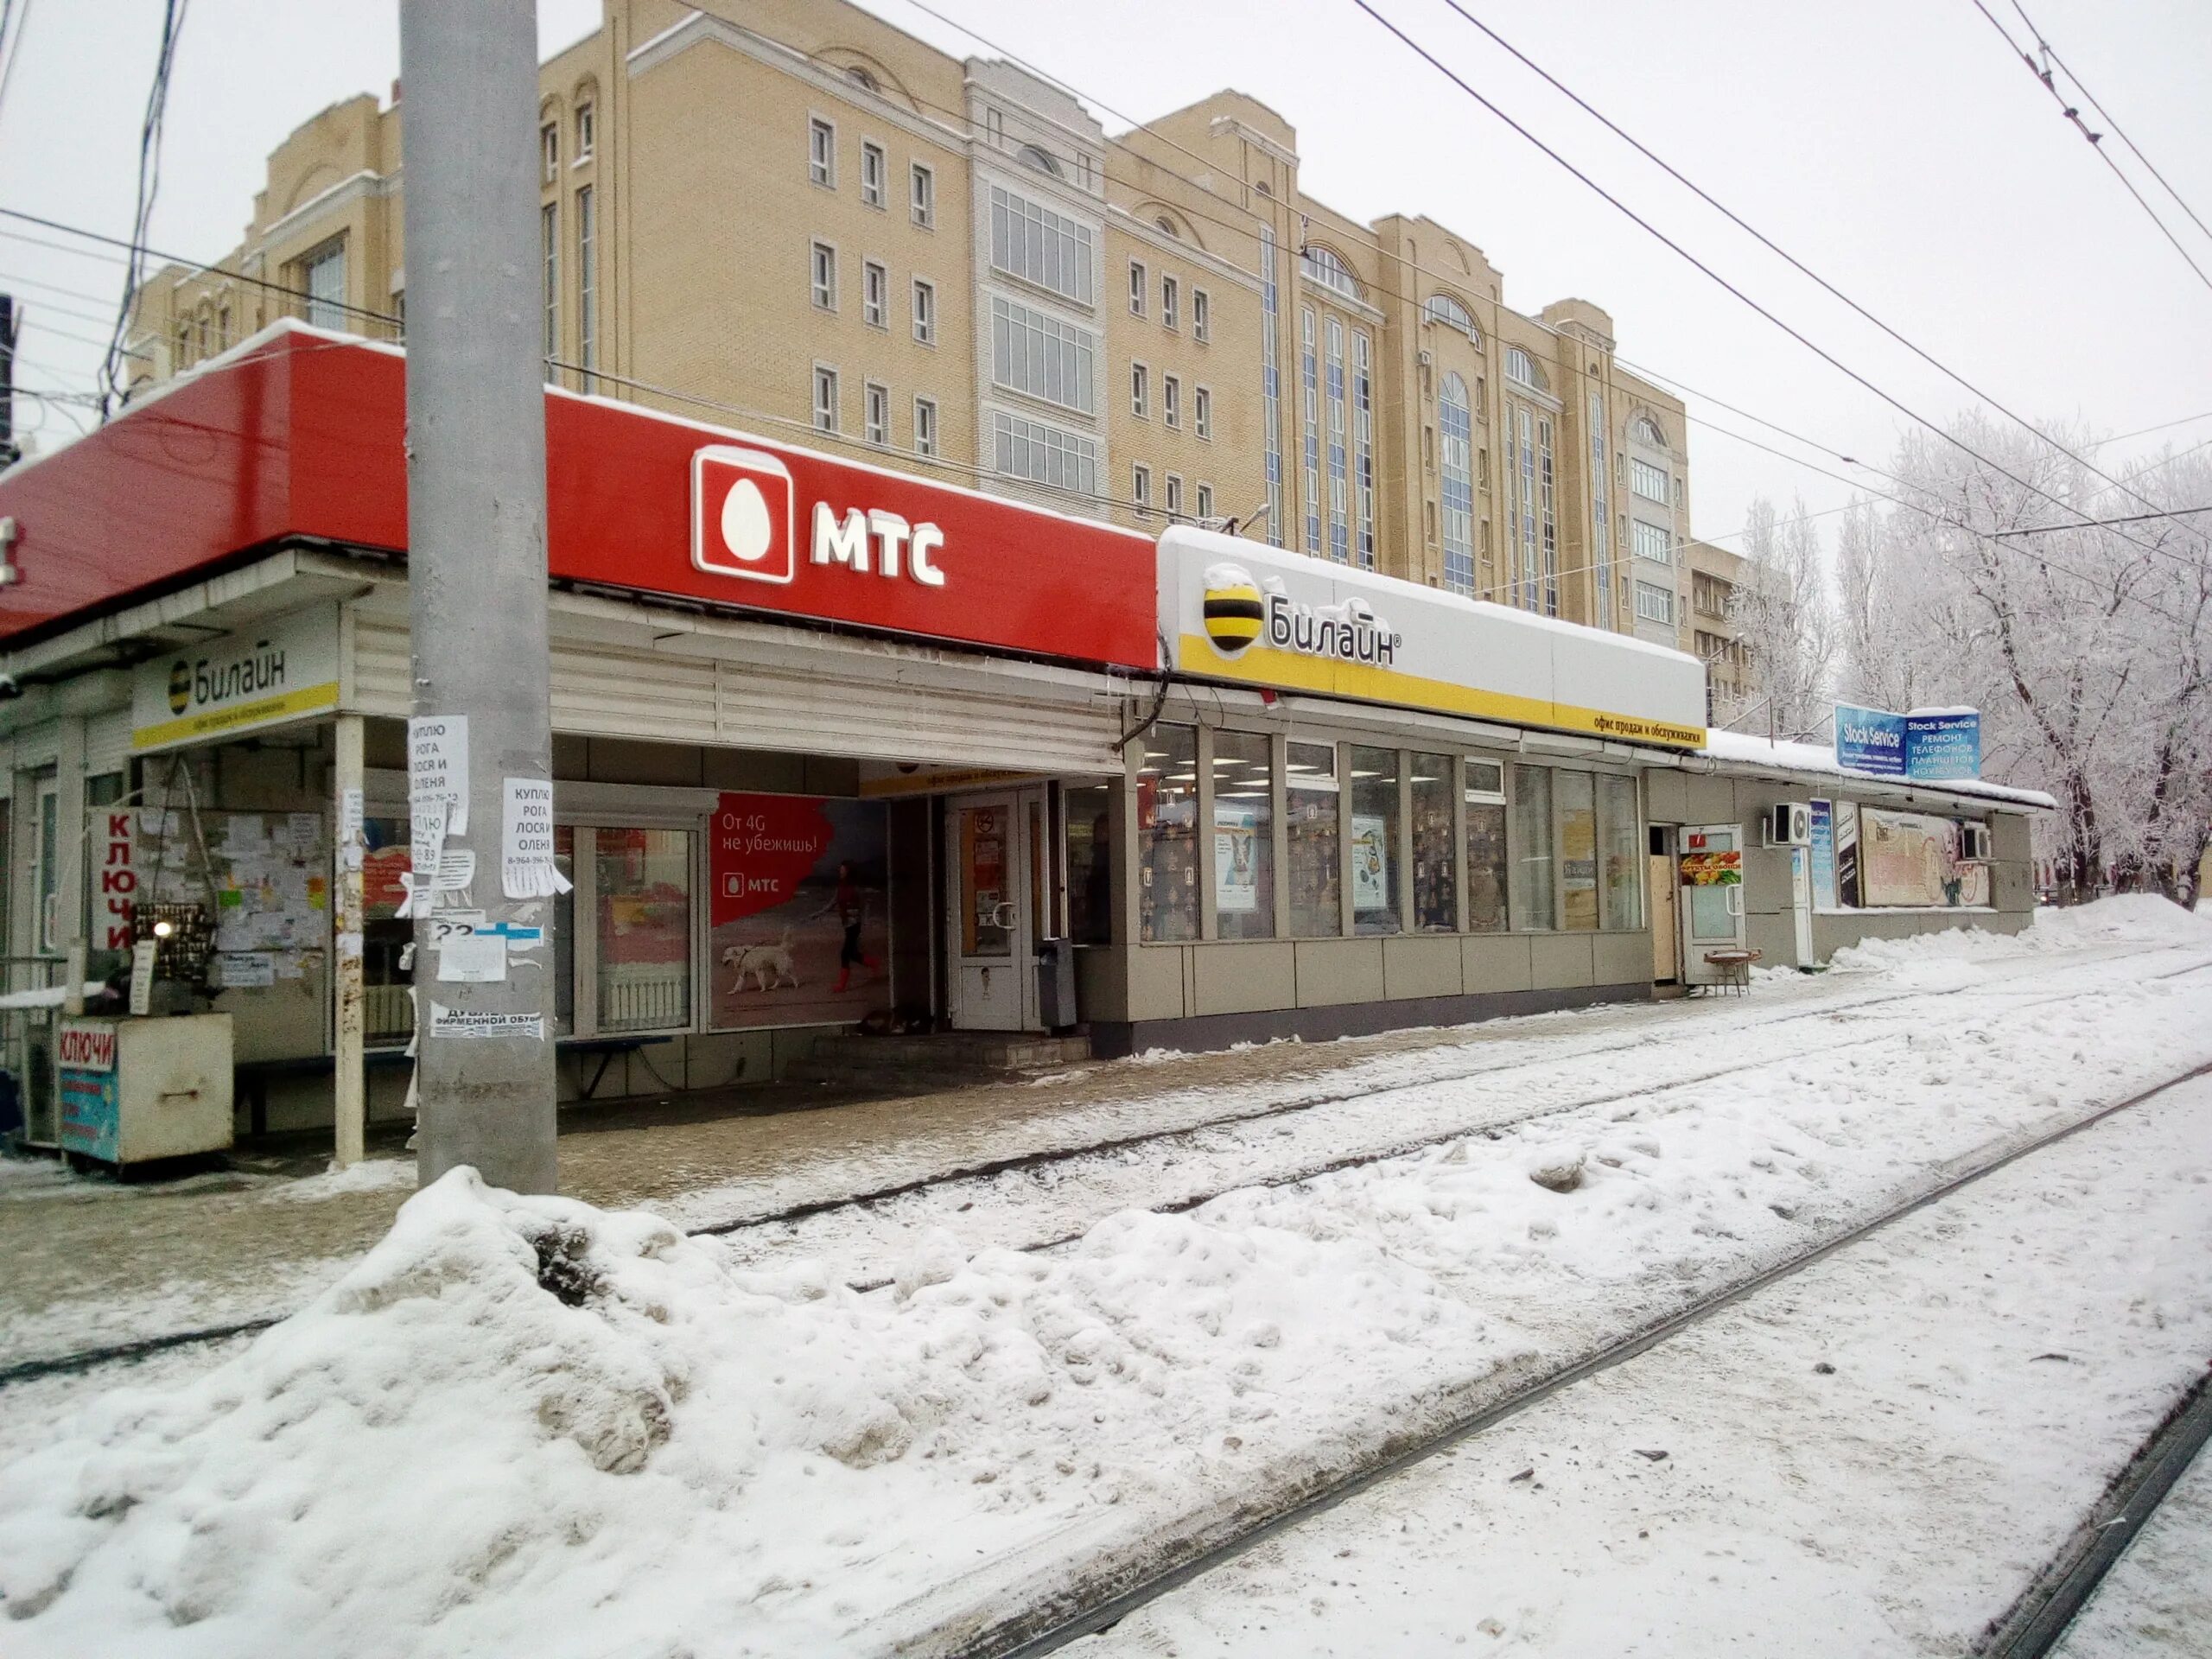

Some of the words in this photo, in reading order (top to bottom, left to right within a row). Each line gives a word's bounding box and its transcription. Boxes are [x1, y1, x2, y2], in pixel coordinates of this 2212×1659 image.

[811, 504, 944, 586] МТС
[194, 639, 285, 704] Билайн
[1594, 715, 1614, 732] офис
[1615, 721, 1643, 735] продаж
[1650, 724, 1700, 743] обслуживания
[1907, 721, 1936, 731] Stock
[1937, 721, 1977, 730] Service
[1843, 722, 1869, 745] Stock
[1869, 727, 1900, 747] Service
[1922, 734, 1963, 743] РЕМОНТ
[1912, 745, 1973, 754] ТЕЛЕФОНОВ
[437, 760, 447, 770] И
[523, 805, 547, 817] РОГА
[516, 823, 544, 833] ЛОСЯ
[722, 813, 742, 830] От
[746, 815, 766, 830] 4G
[722, 837, 741, 850] не
[745, 833, 817, 855] убежишь!
[102, 815, 138, 950] КЛЮЧИ
[748, 879, 779, 892] МТС
[435, 1016, 506, 1026] ФИРМЕННОЙ
[60, 1030, 114, 1065] КЛЮЧИ
